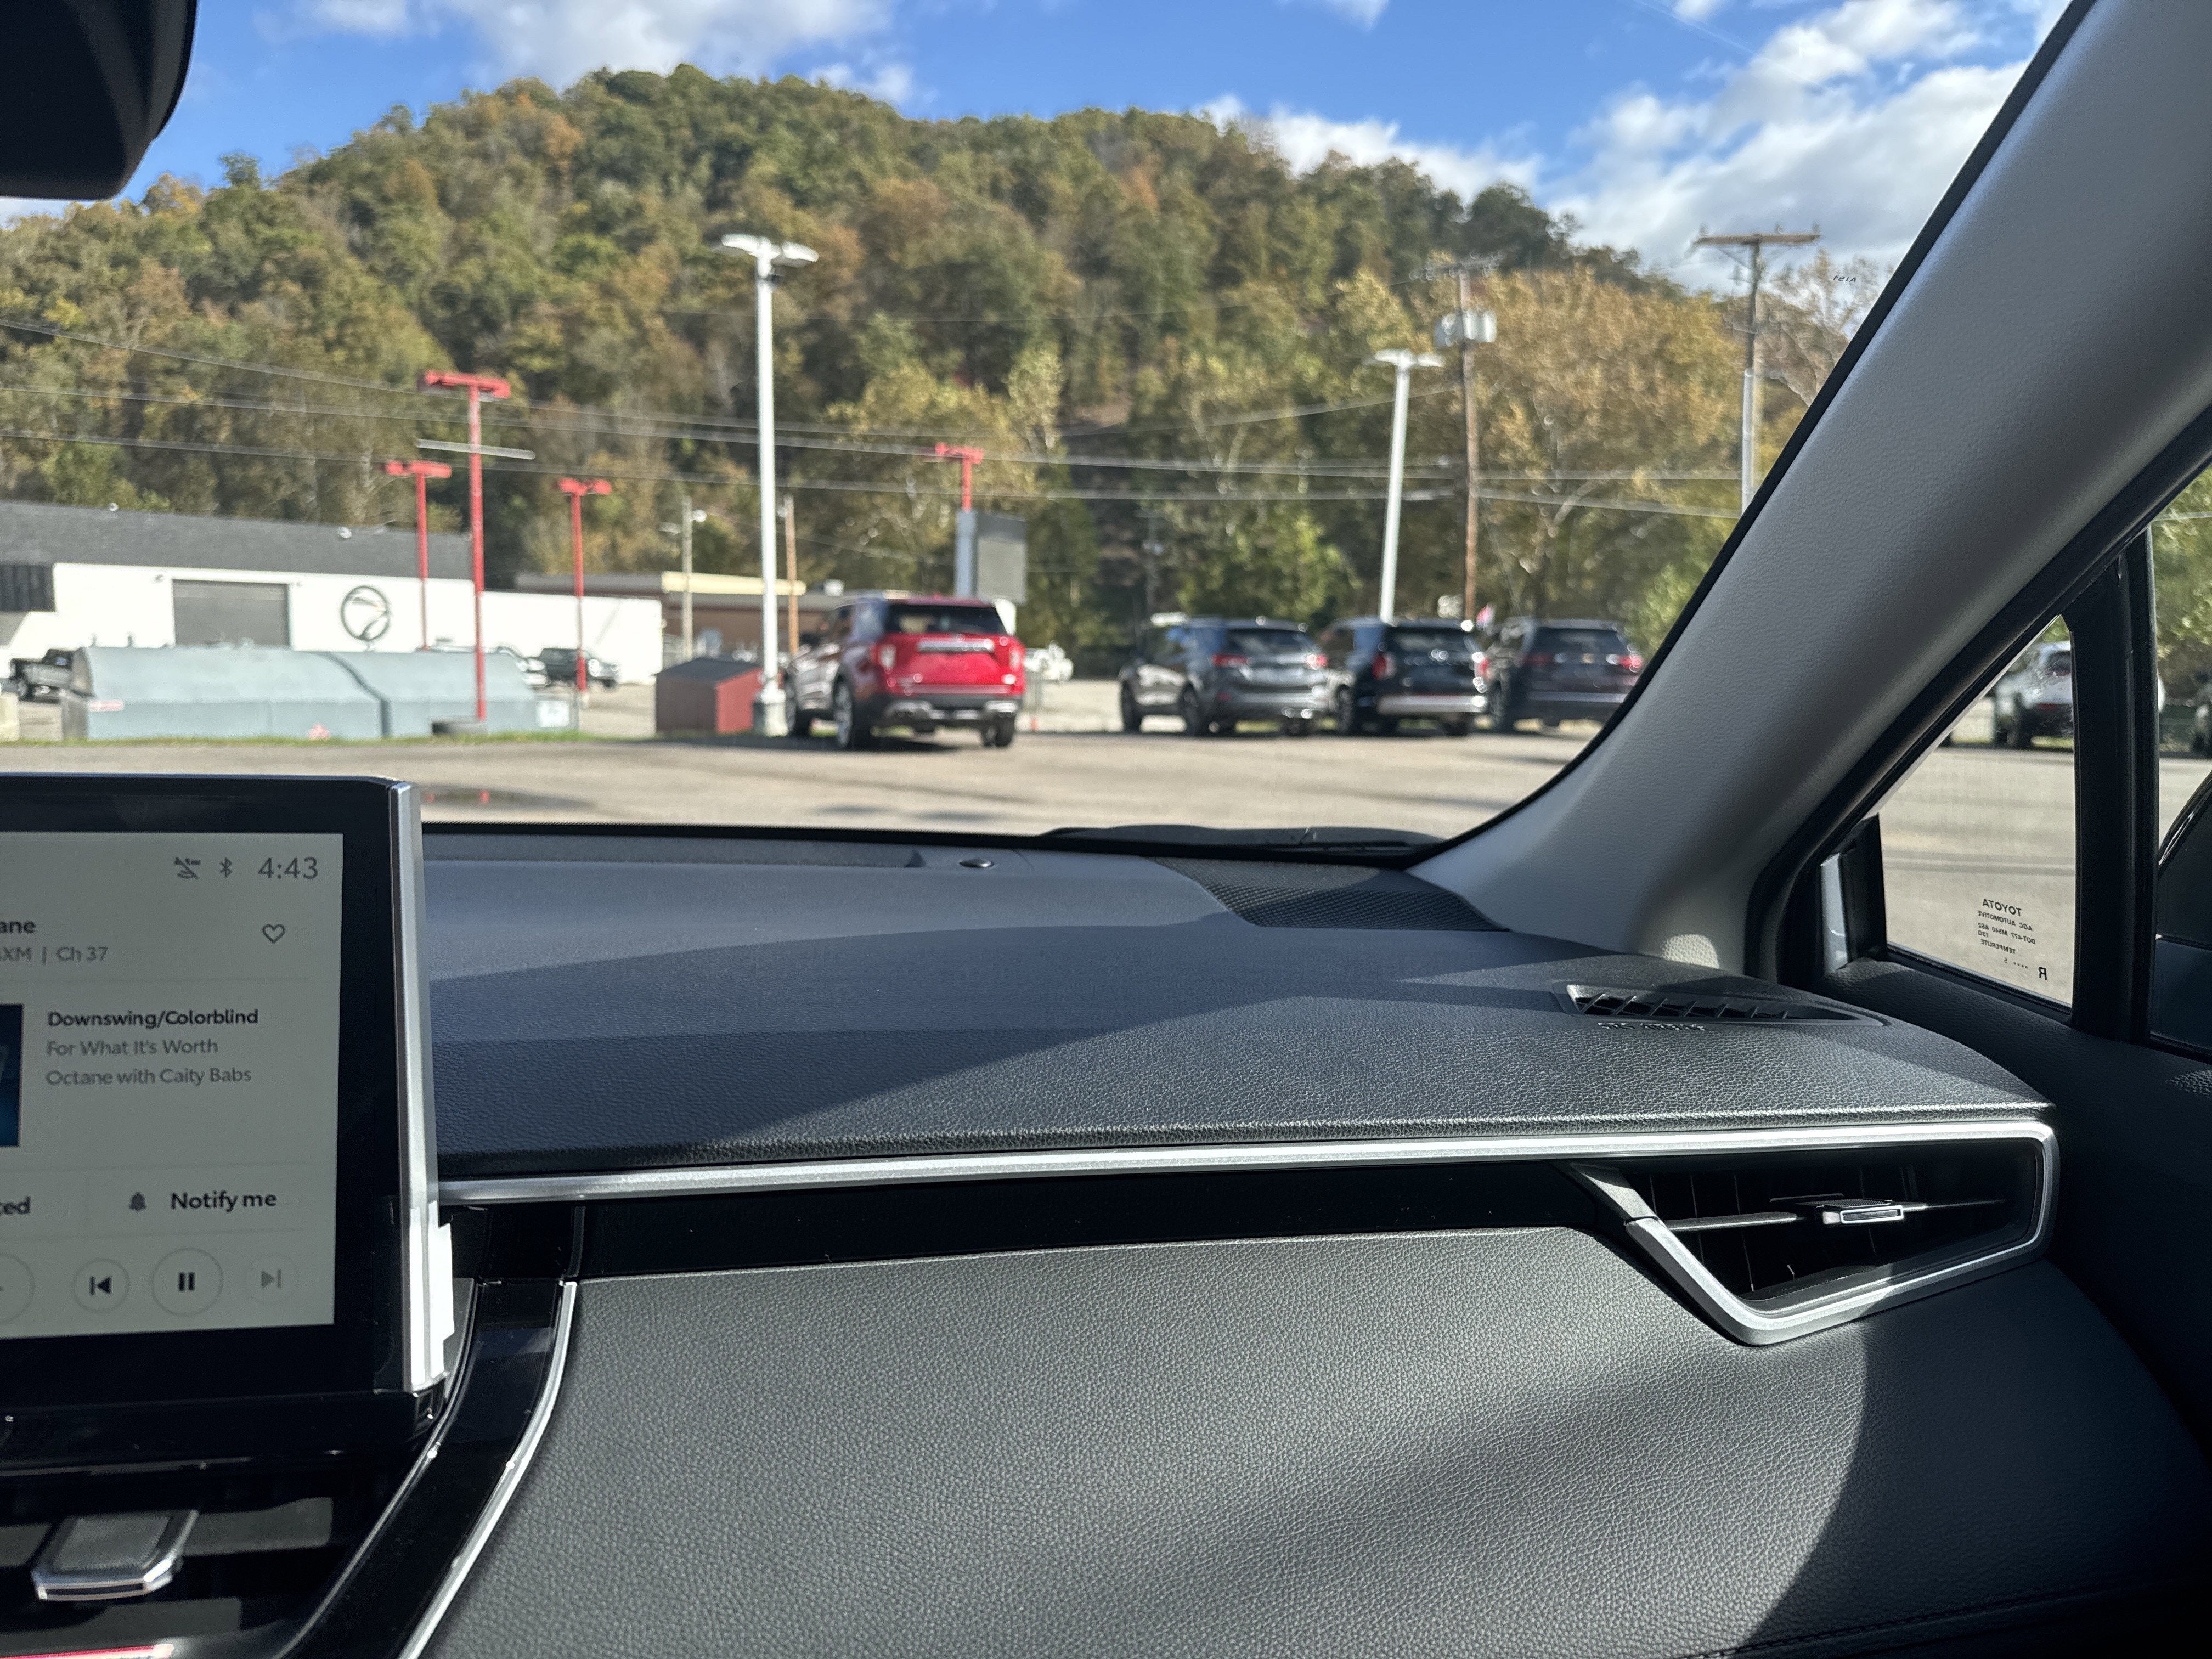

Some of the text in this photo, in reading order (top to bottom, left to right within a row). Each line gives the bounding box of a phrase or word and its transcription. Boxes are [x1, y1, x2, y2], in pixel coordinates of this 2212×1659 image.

[258, 856, 318, 879] 4:43
[0, 947, 32, 962] XM
[57, 946, 82, 962] Ch
[87, 946, 109, 961] 37
[49, 1009, 258, 1029] Downswing/Colorblind
[47, 1041, 75, 1056] For
[80, 1040, 128, 1056] What
[163, 1039, 218, 1054] Worth
[46, 1067, 251, 1087] Octane with Caity Babs
[171, 1190, 277, 1212] Notify me
